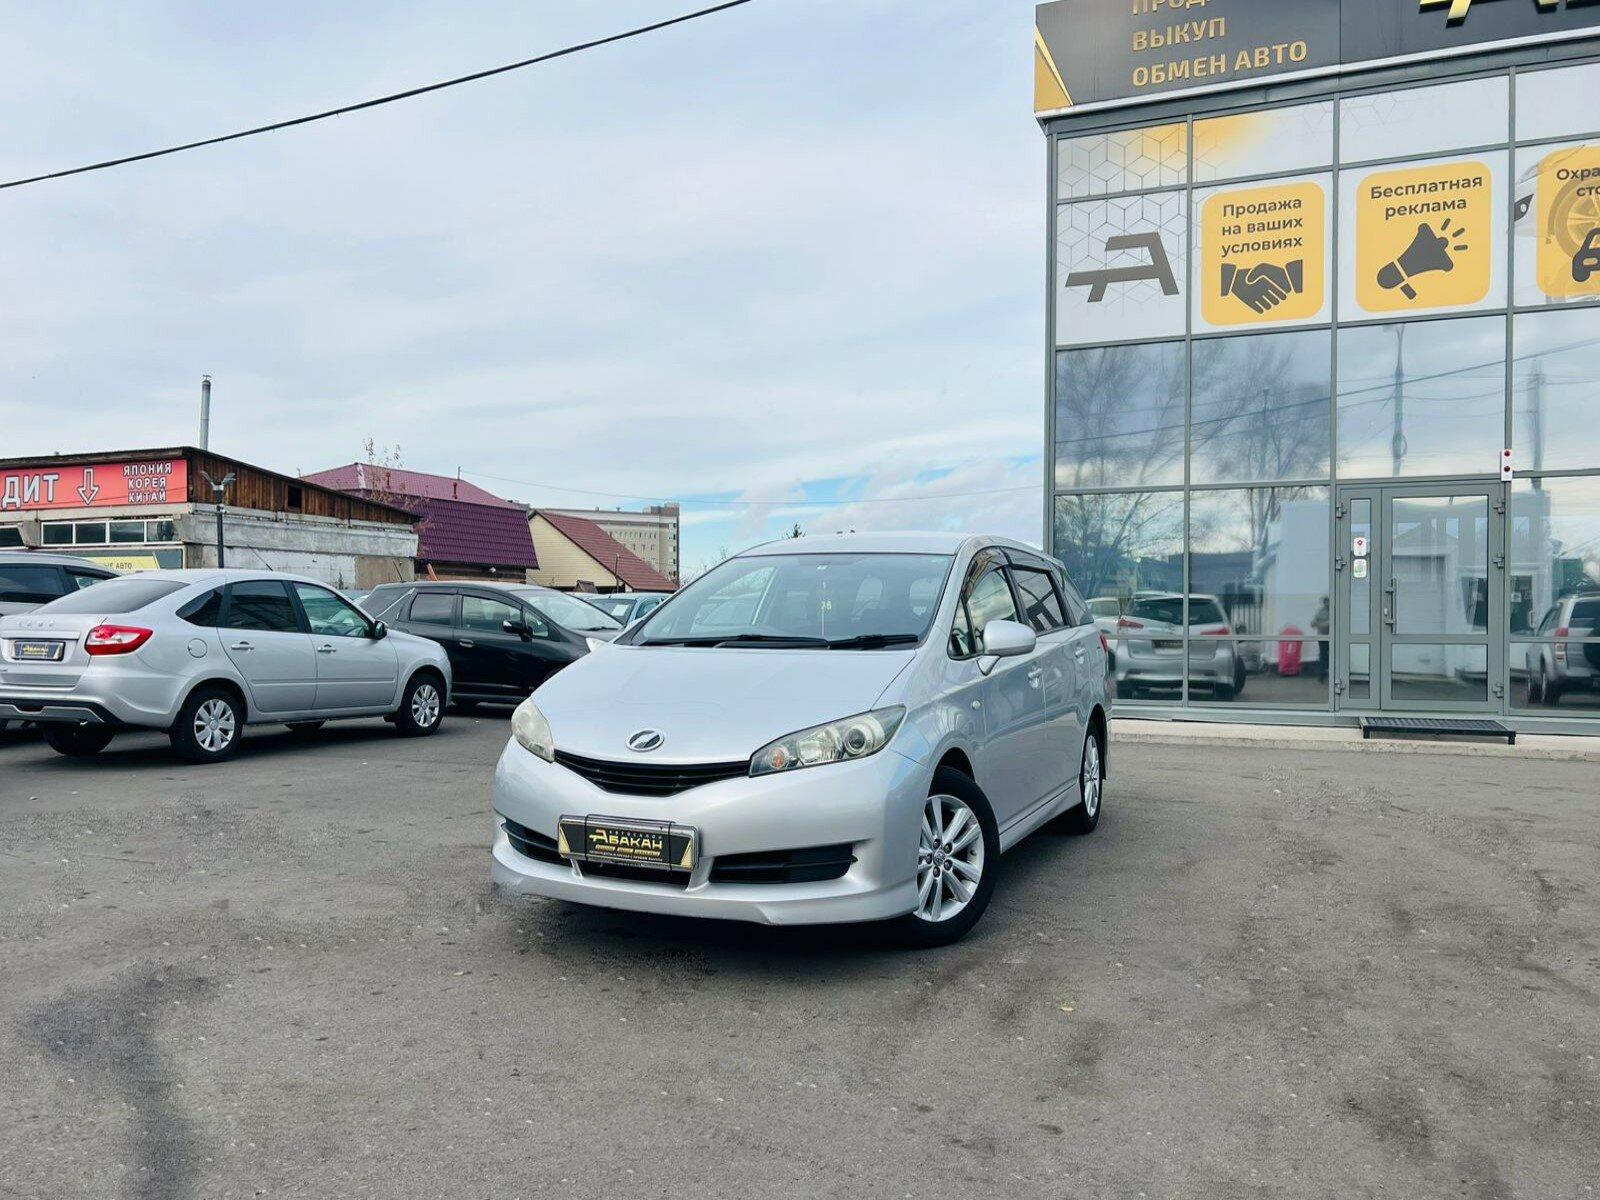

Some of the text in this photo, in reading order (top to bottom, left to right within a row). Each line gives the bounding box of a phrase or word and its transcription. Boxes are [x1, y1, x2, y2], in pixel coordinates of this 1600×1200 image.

[1132, 17, 1226, 51] ВЫКУП
[1132, 40, 1308, 87] ОБМЕН АВТО
[1370, 176, 1483, 200] Бесплатная
[1223, 198, 1302, 219] Продажа
[1385, 198, 1467, 221] реклама
[1222, 217, 1304, 236] на ваших
[1221, 236, 1303, 258] условиях
[123, 462, 173, 476] ЯПОНИЯ
[2, 473, 60, 511] ДИТ
[128, 476, 166, 488] КОРЕЯ
[128, 488, 166, 503] КИТАЙ
[588, 828, 663, 850] АБАКАН
